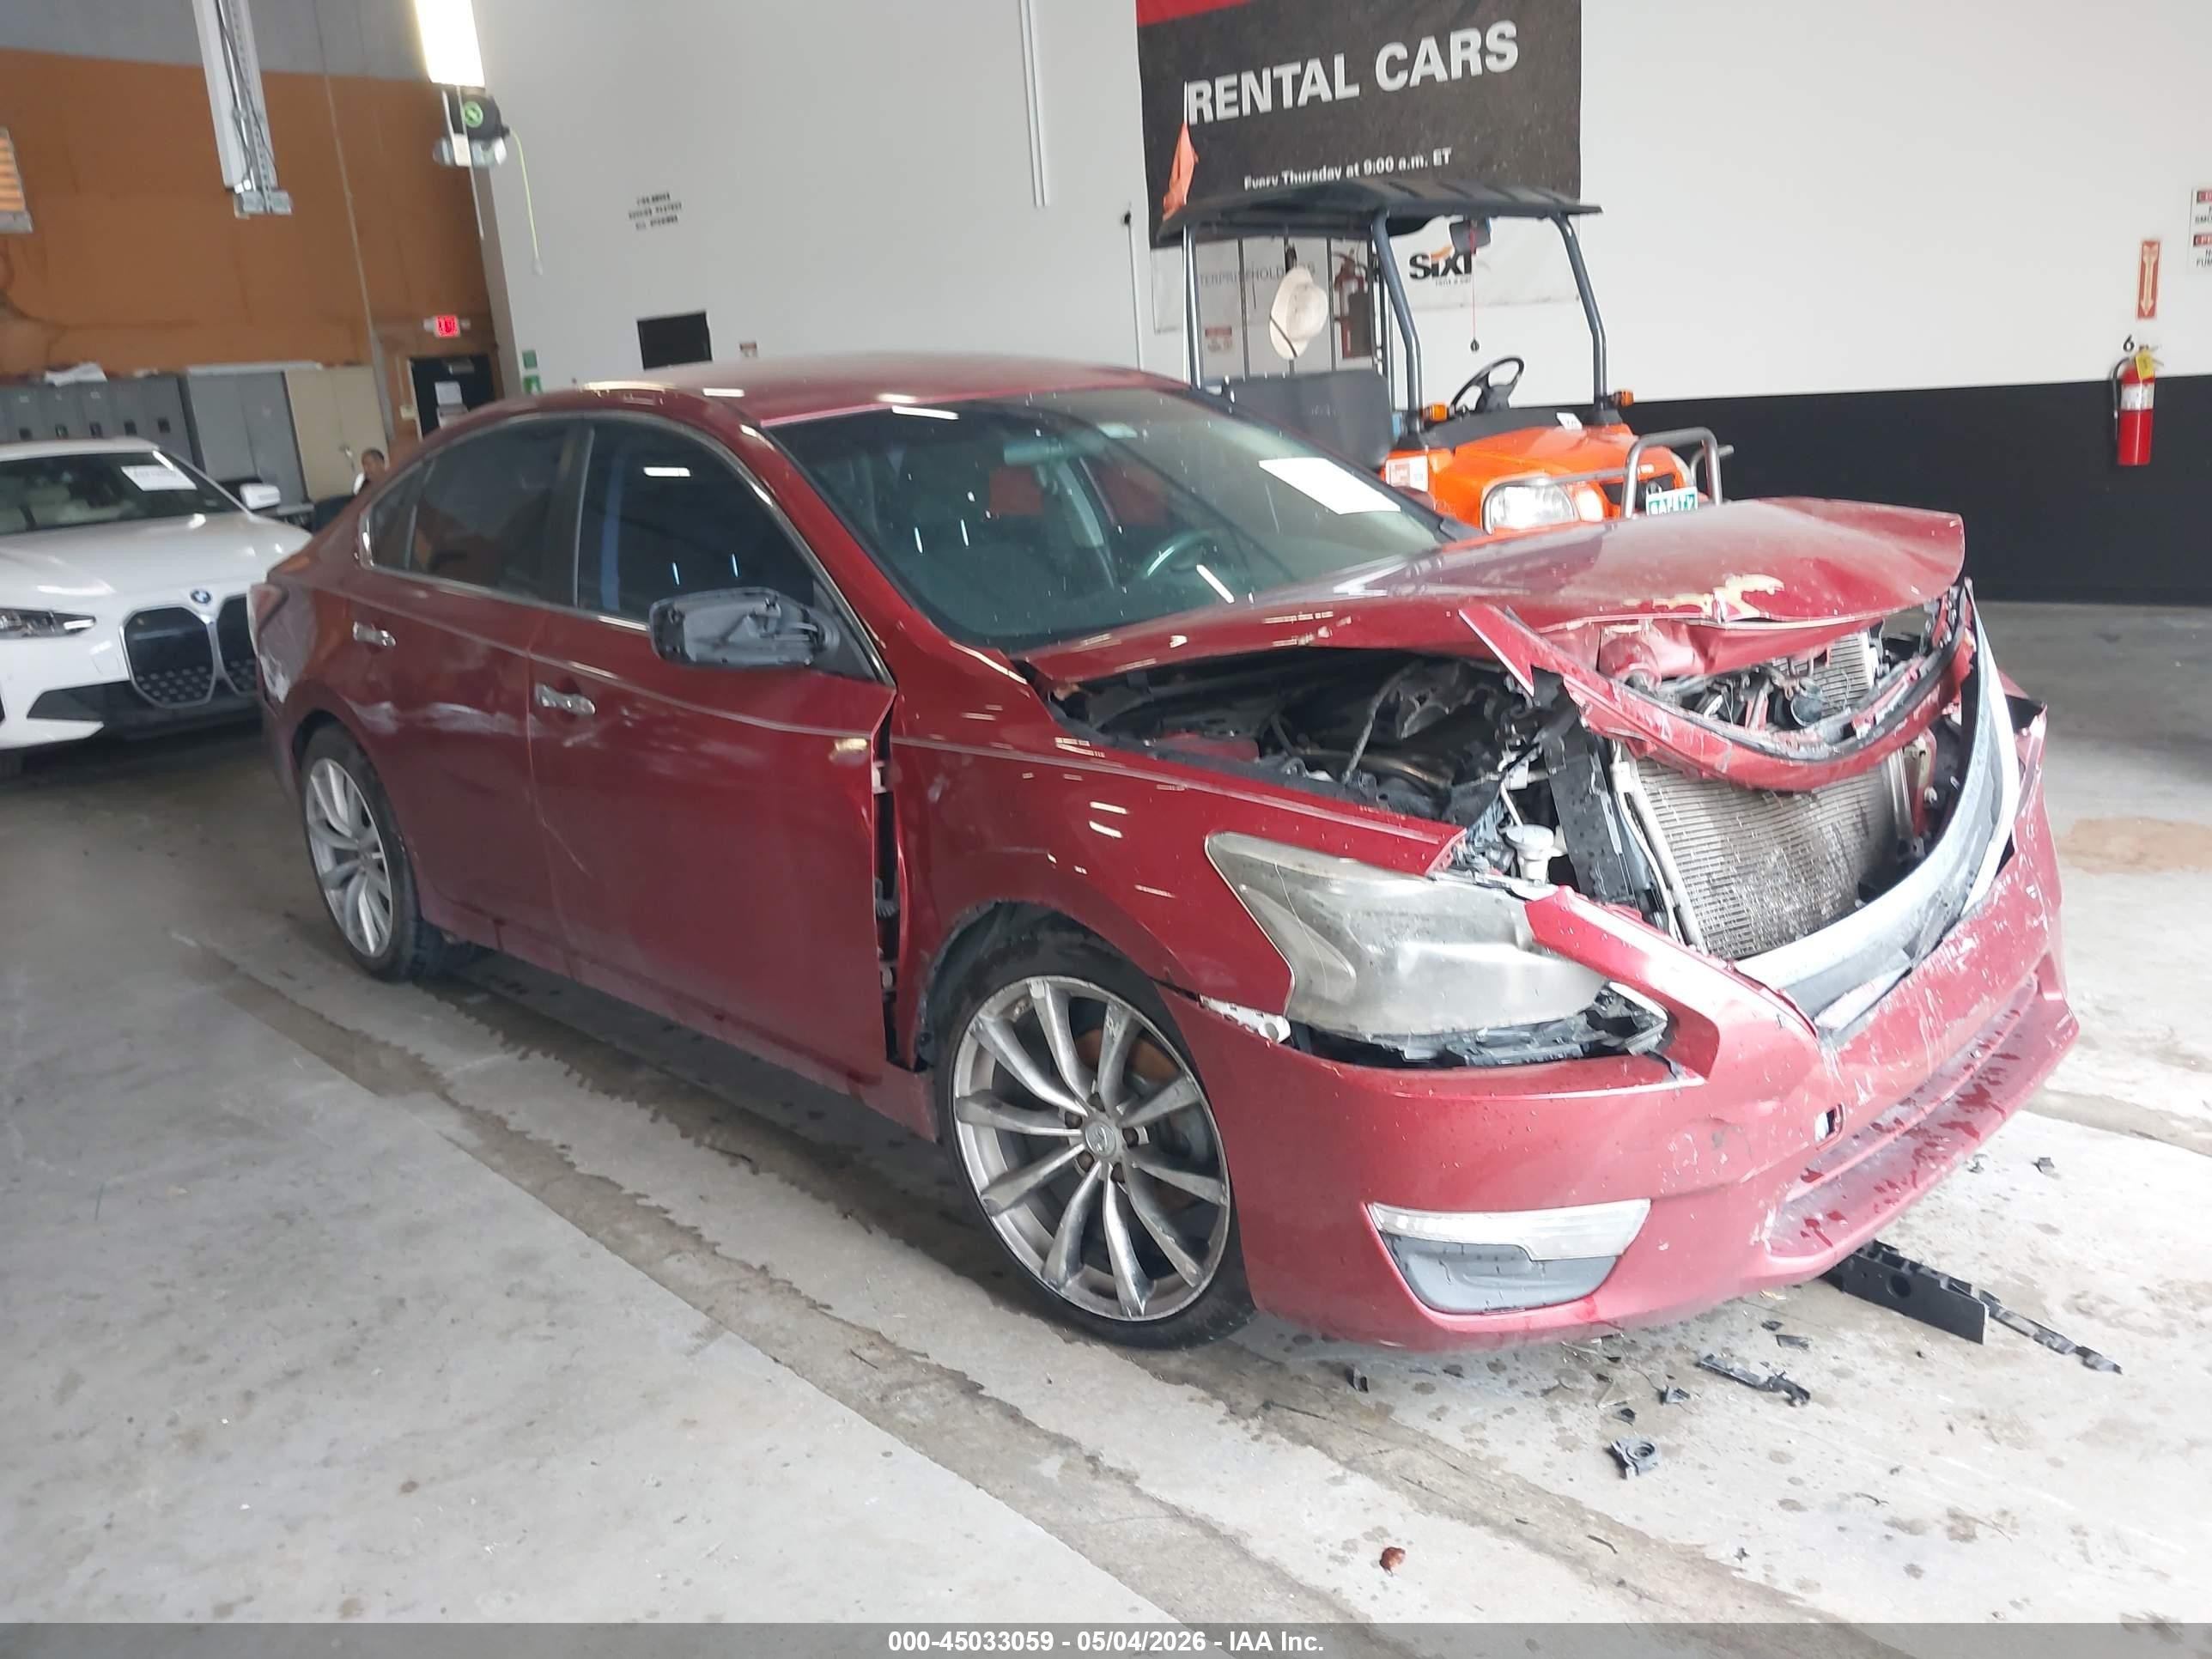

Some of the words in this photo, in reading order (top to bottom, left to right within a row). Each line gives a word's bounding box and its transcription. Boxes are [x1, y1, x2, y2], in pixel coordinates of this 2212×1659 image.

[1188, 52, 1360, 125] RENTAL
[1375, 19, 1519, 92] CARS
[1281, 165, 1342, 185] Thursday
[1346, 161, 1359, 179] at
[1364, 155, 1395, 176] 9:00
[1399, 153, 1428, 171] a.m.
[1433, 147, 1452, 167] ET
[2123, 334, 2135, 351] 6
